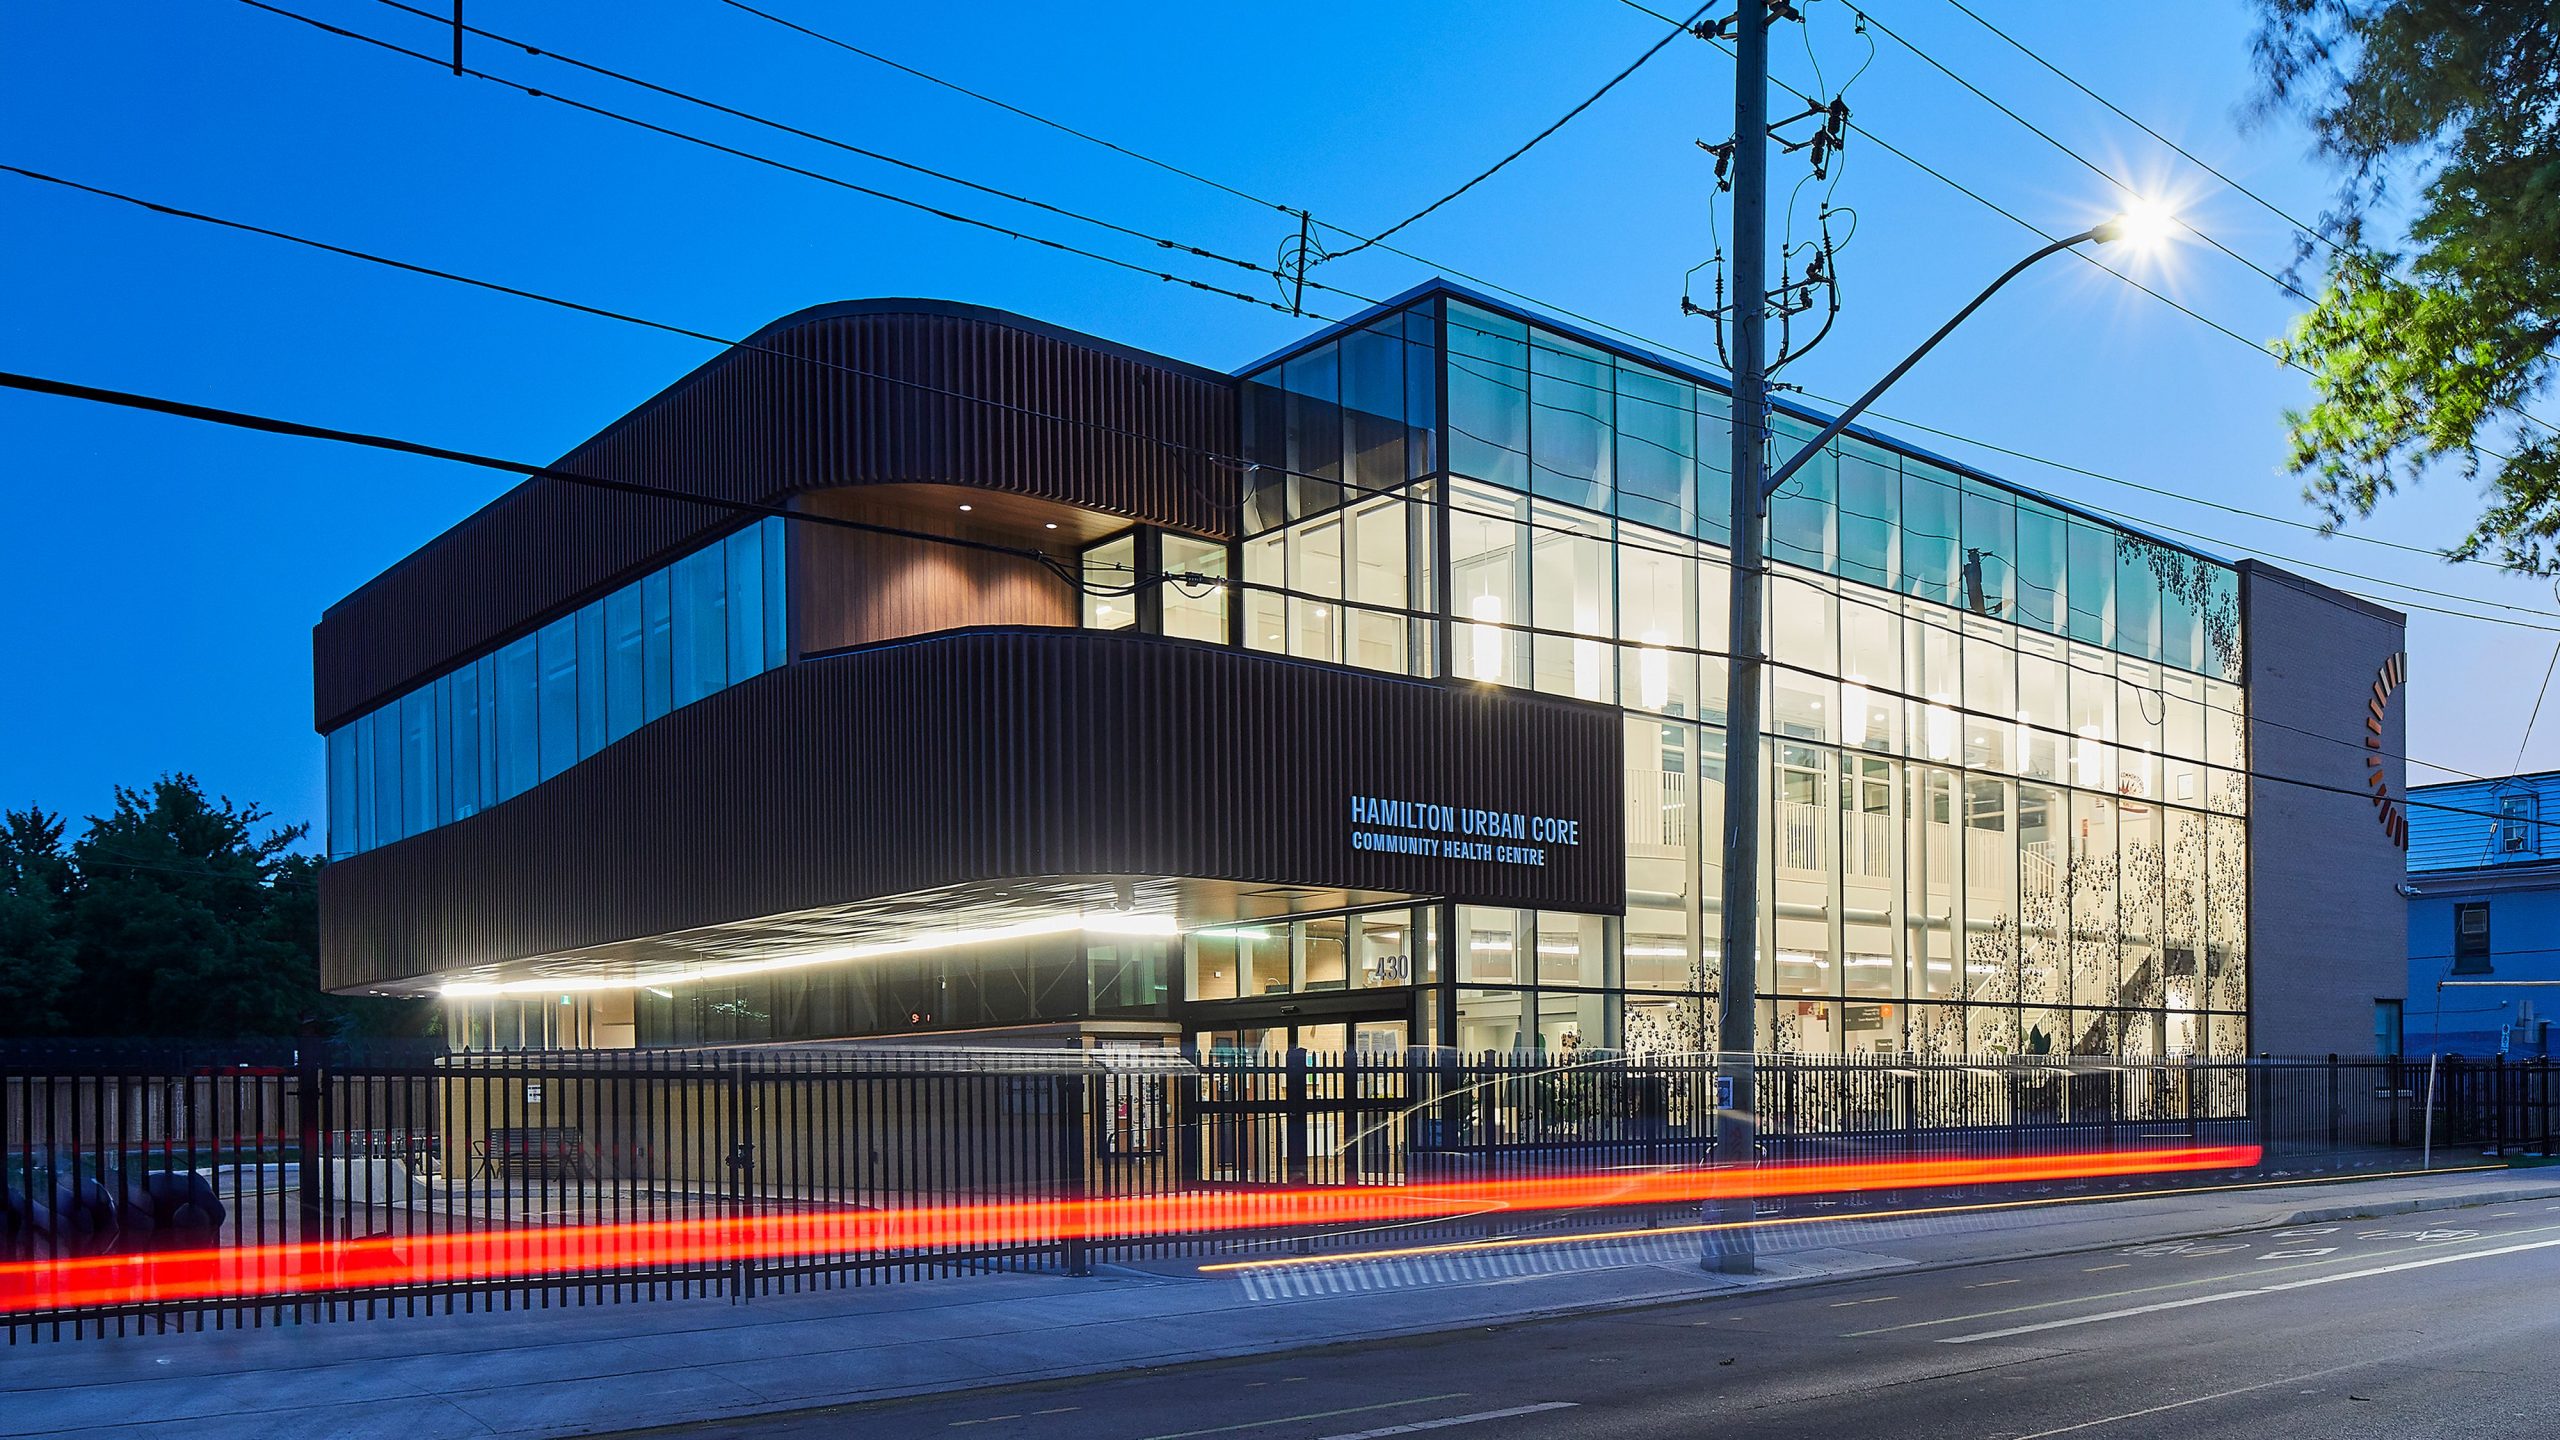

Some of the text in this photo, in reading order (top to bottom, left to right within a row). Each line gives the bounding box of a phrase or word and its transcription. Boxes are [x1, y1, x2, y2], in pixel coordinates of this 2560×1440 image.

[1351, 795, 1579, 846] HAMILTON URBAN CORE
[1352, 831, 1545, 866] COMMUNITY HEALTH CENTRE
[1376, 955, 1408, 980] 430
